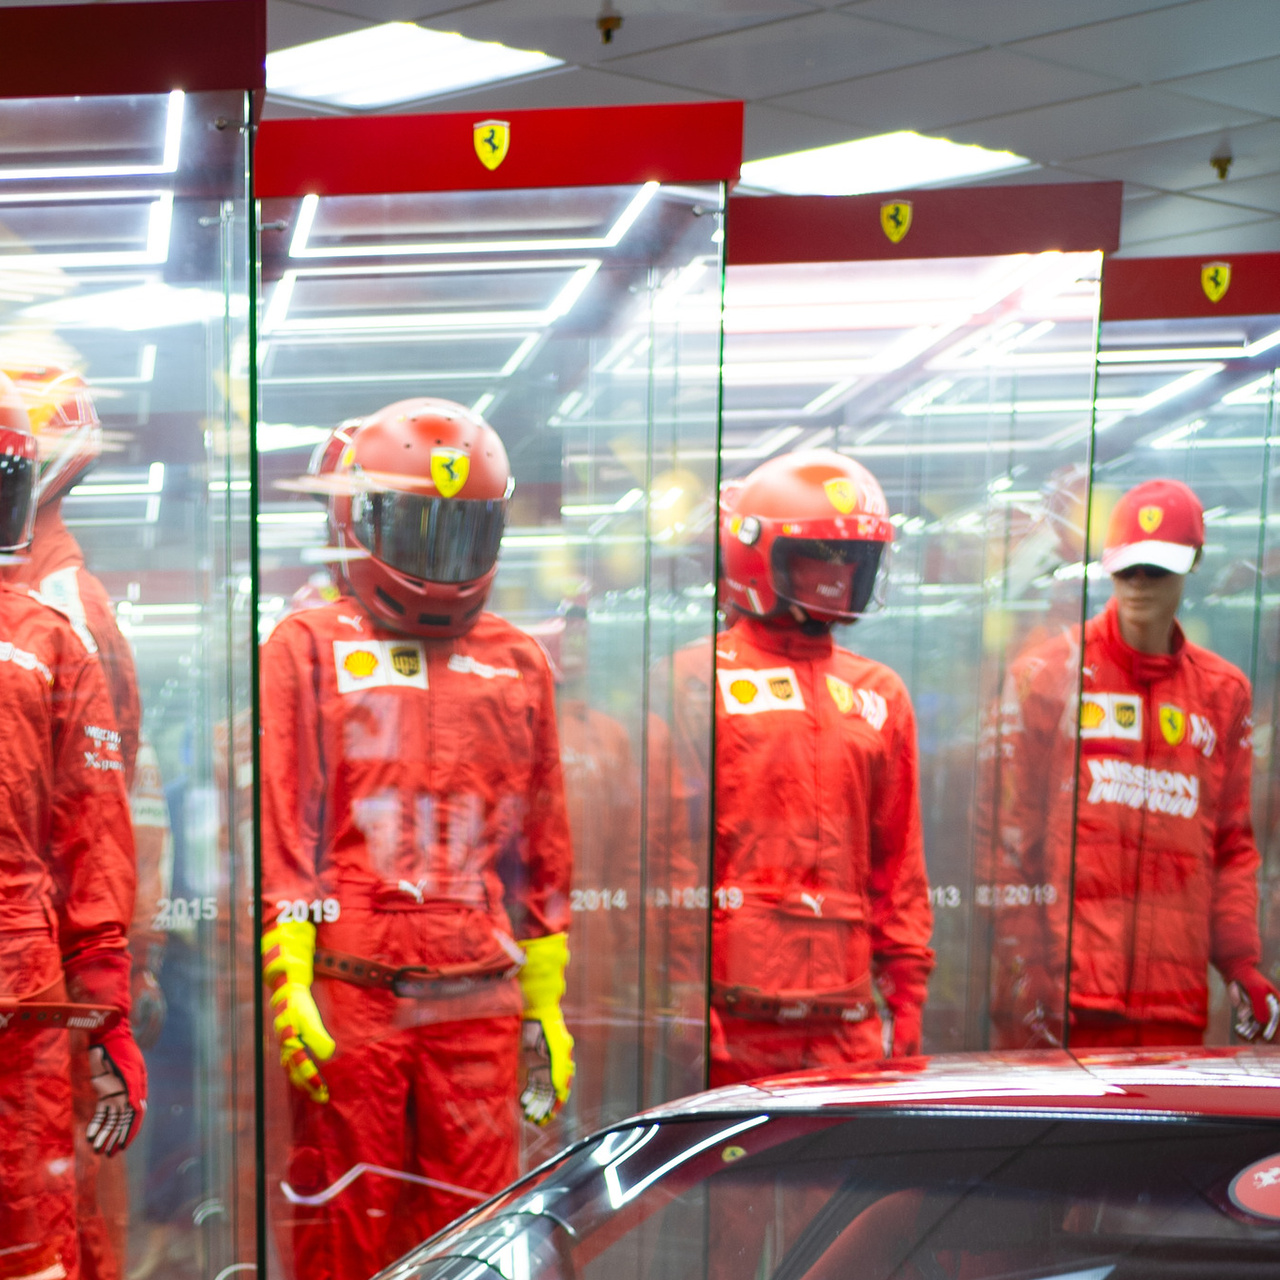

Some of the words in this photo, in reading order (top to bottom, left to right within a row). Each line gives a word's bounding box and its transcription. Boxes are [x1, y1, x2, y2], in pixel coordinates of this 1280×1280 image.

[1087, 759, 1199, 799] MISSION
[156, 897, 218, 920] 2015
[276, 899, 341, 924] 2019
[570, 888, 627, 912] 2014
